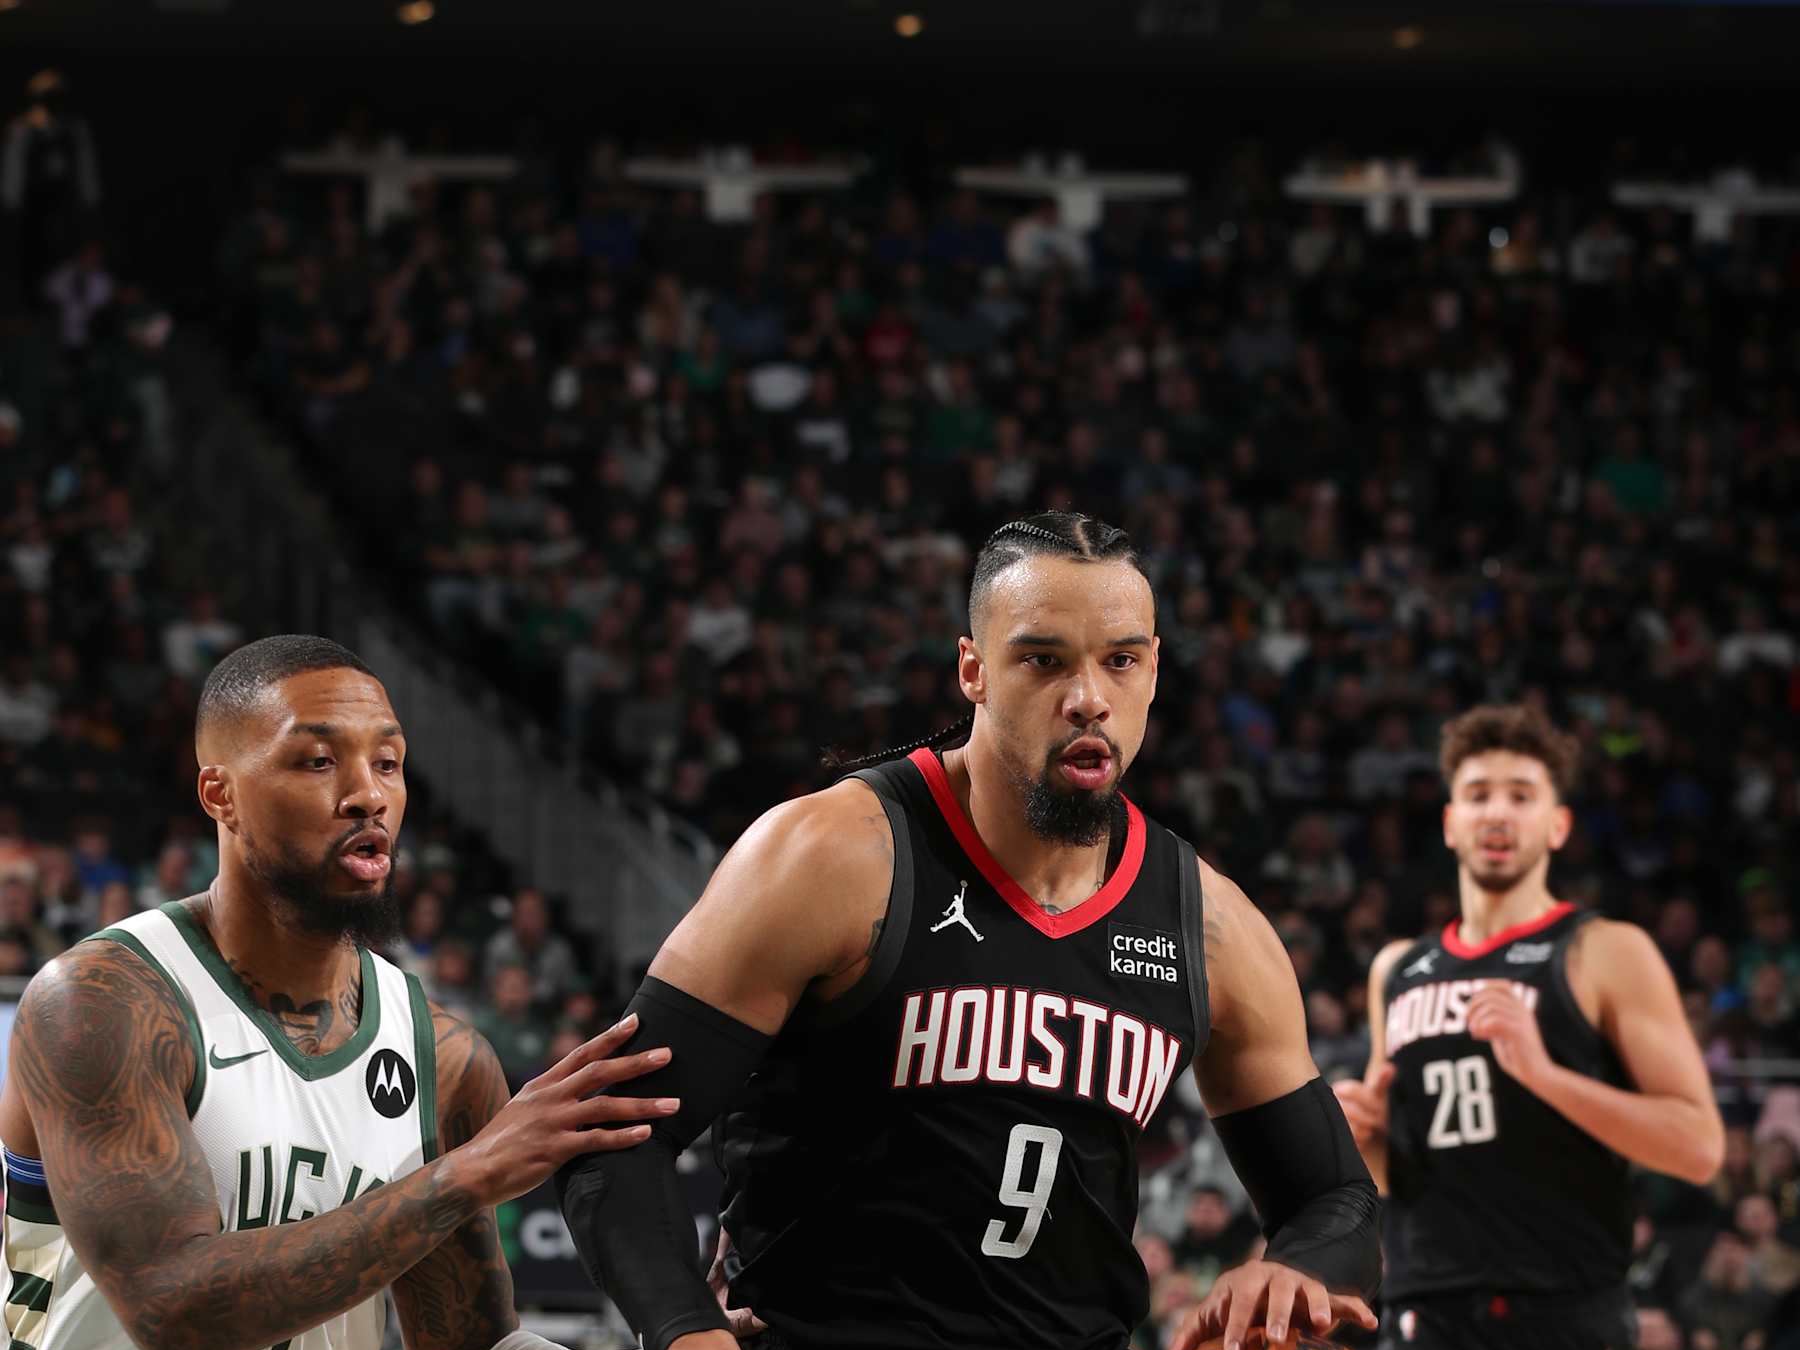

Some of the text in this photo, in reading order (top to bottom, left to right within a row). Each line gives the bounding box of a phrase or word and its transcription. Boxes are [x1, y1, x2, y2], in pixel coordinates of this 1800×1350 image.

[1110, 949, 1178, 983] karma
[1112, 934, 1177, 960] credit
[891, 985, 1183, 1131] HOUSTON
[1422, 1055, 1497, 1149] 28
[981, 1123, 1063, 1259] 9
